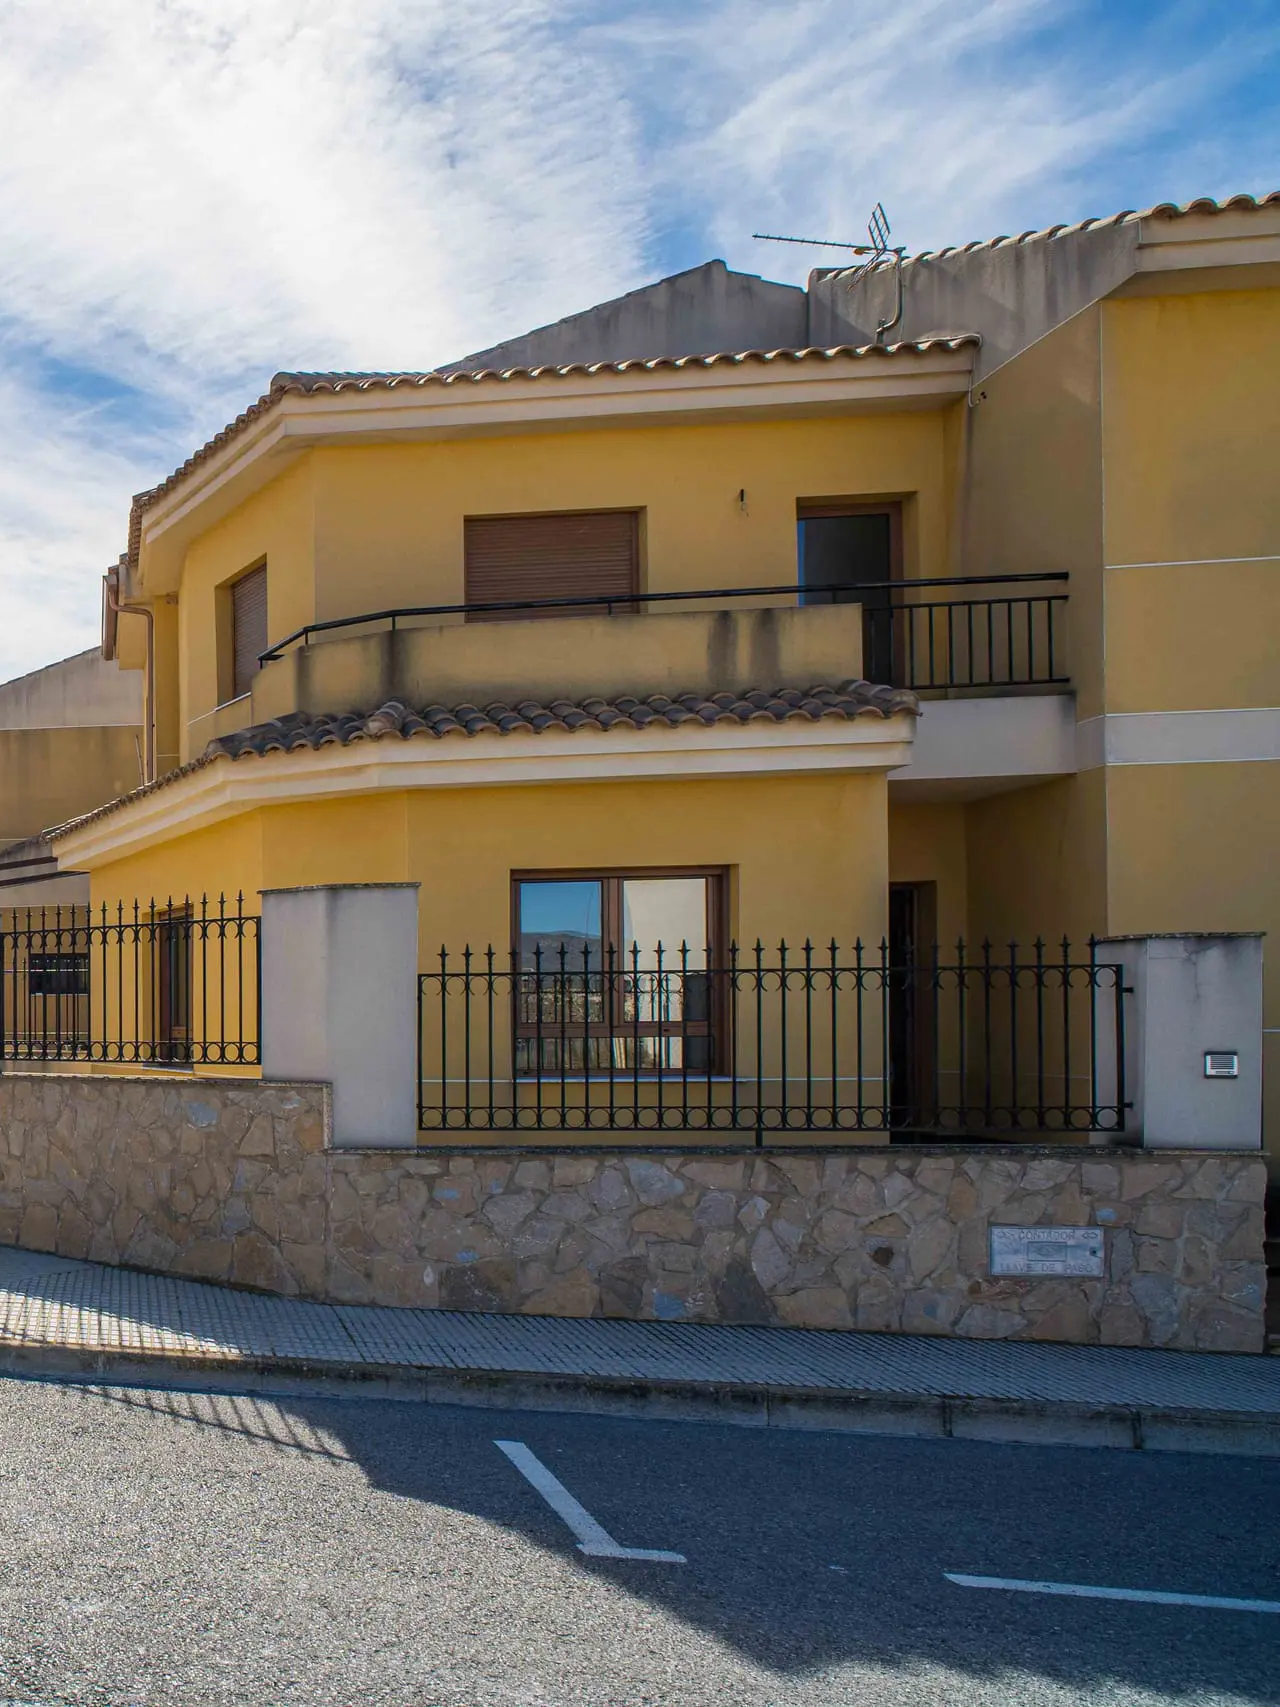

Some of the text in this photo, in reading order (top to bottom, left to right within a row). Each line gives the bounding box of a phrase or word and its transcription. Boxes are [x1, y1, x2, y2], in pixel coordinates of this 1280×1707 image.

[1020, 1229, 1076, 1241] CONTADOR
[1000, 1263, 1093, 1273] LLAVE DE PASO
